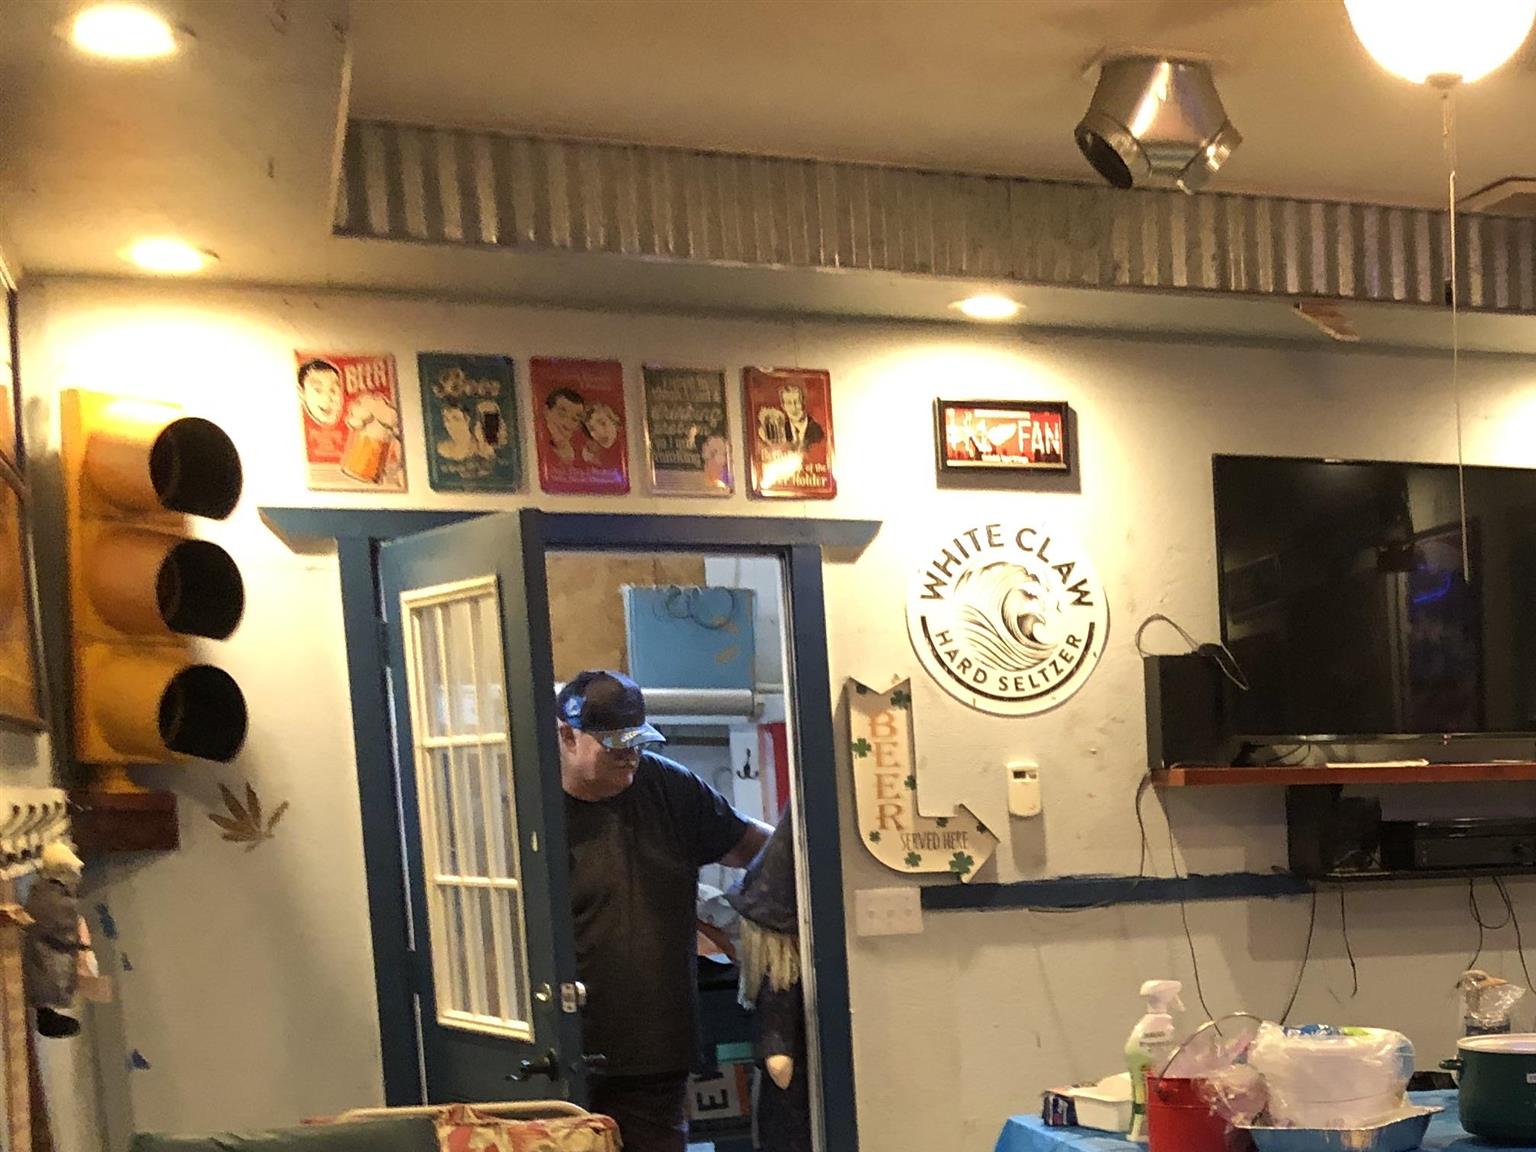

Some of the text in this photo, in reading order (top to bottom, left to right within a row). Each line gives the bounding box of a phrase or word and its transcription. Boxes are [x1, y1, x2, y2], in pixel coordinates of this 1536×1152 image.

[1018, 420, 1060, 455] FAN
[920, 524, 1094, 607] WHITE CLAW
[936, 630, 1082, 692] HARD SELTZER
[868, 710, 905, 831] BEER
[901, 831, 968, 851] SERVED HERE
